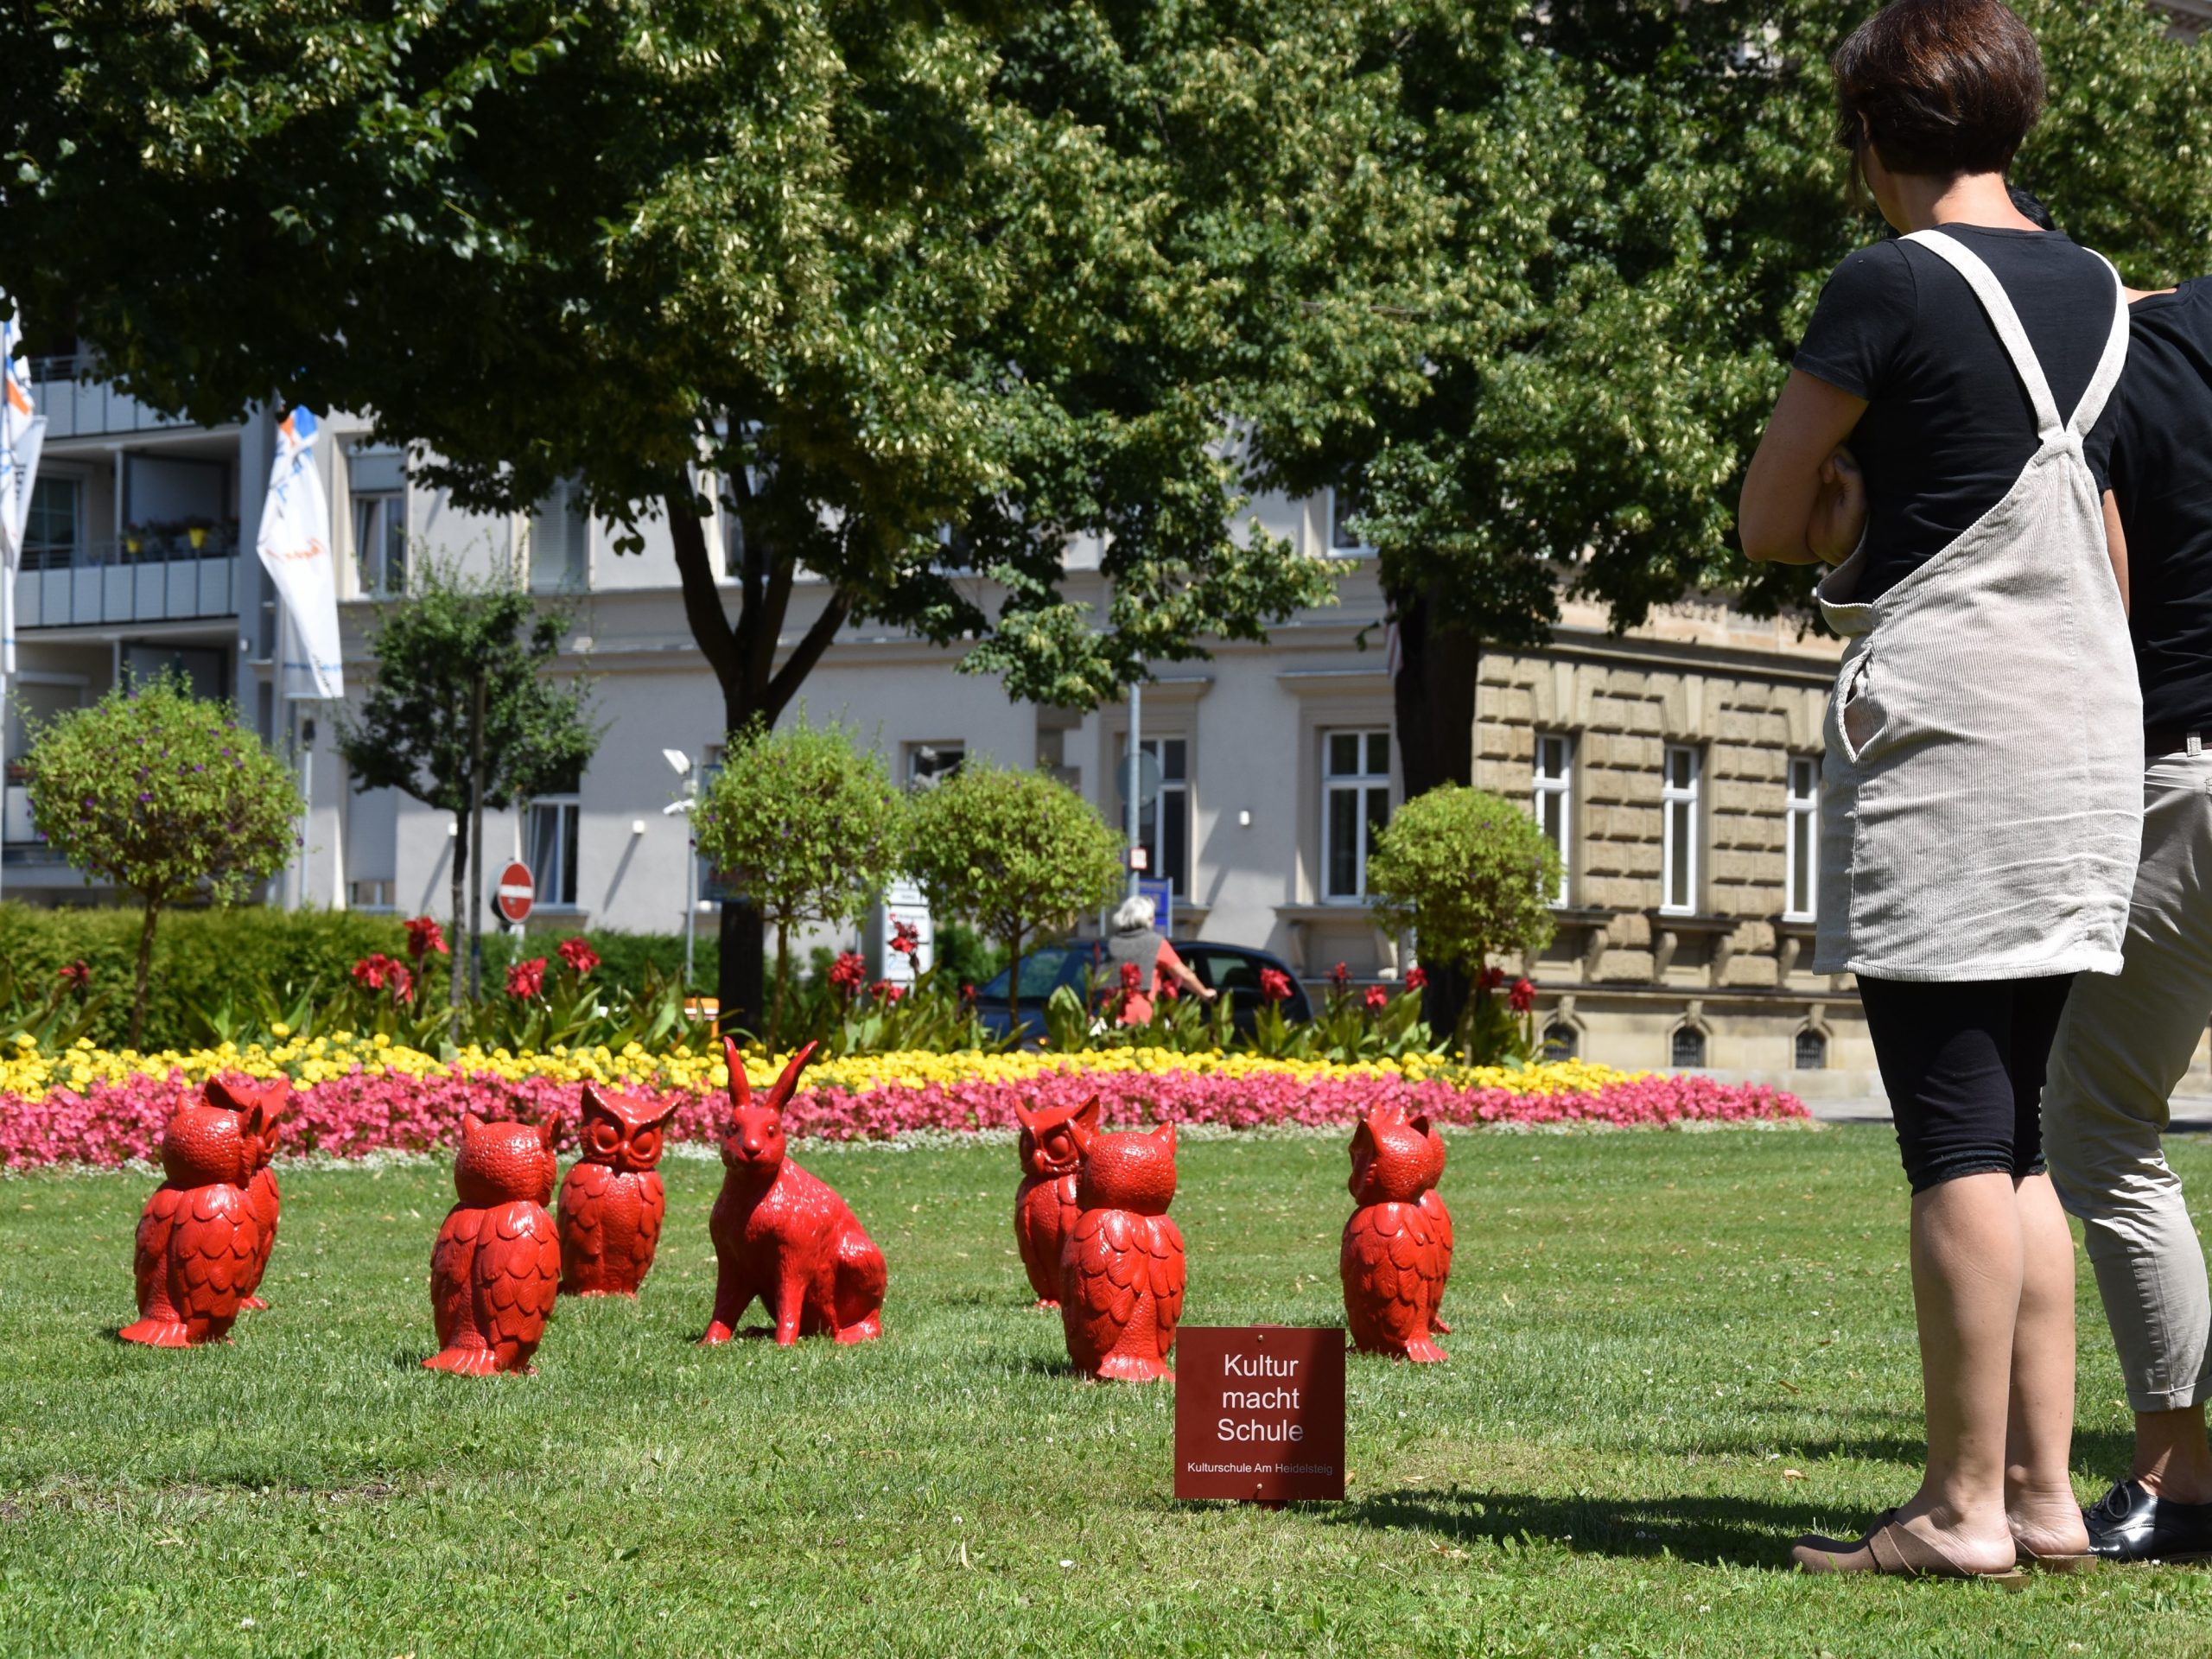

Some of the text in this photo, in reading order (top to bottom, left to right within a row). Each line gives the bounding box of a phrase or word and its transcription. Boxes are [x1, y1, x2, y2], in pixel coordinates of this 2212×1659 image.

[1224, 1354, 1299, 1376] Kultur
[1223, 1387, 1300, 1409] macht
[1217, 1418, 1303, 1441] Schule
[1187, 1462, 1332, 1476] Kulturschule Am Heidelsteig
